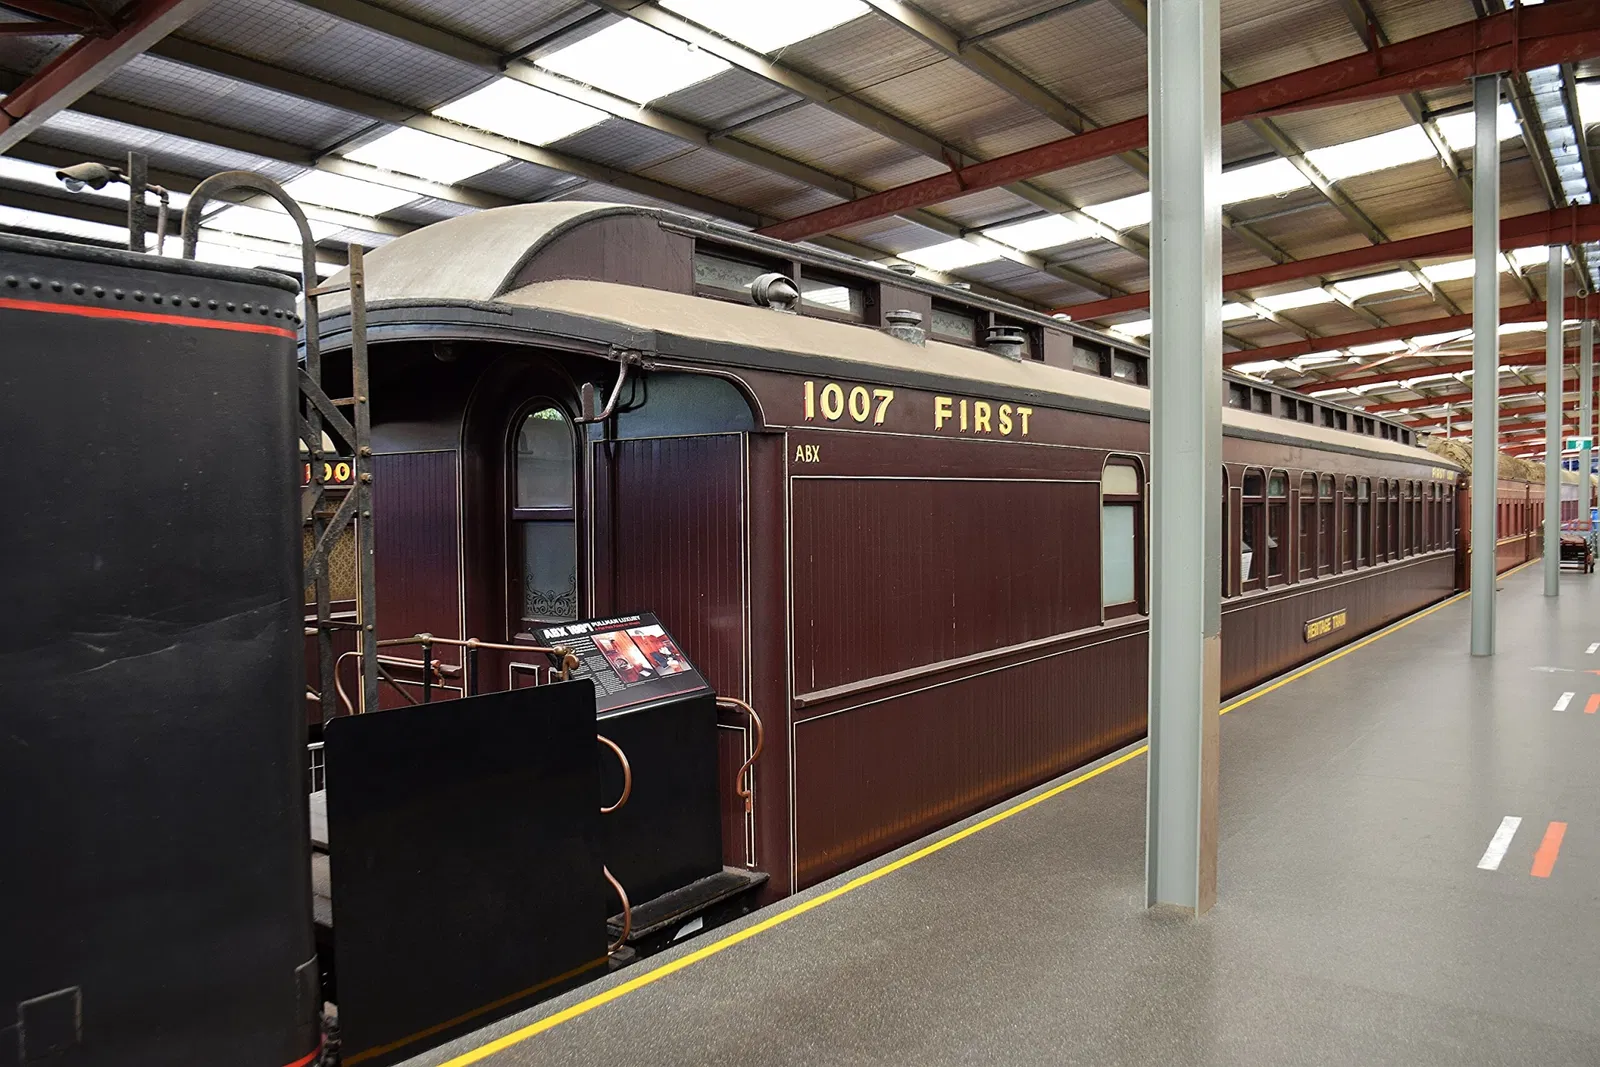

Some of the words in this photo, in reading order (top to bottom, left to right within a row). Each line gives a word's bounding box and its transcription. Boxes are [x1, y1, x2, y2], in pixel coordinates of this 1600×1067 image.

[803, 381, 894, 427] 1007
[933, 395, 1033, 437] FIRST
[794, 444, 820, 463] ABX
[590, 618, 619, 627] PULLMAN
[619, 615, 640, 623] LUXURY
[1307, 617, 1332, 639] HERITAGE
[543, 627, 569, 639] ABX
